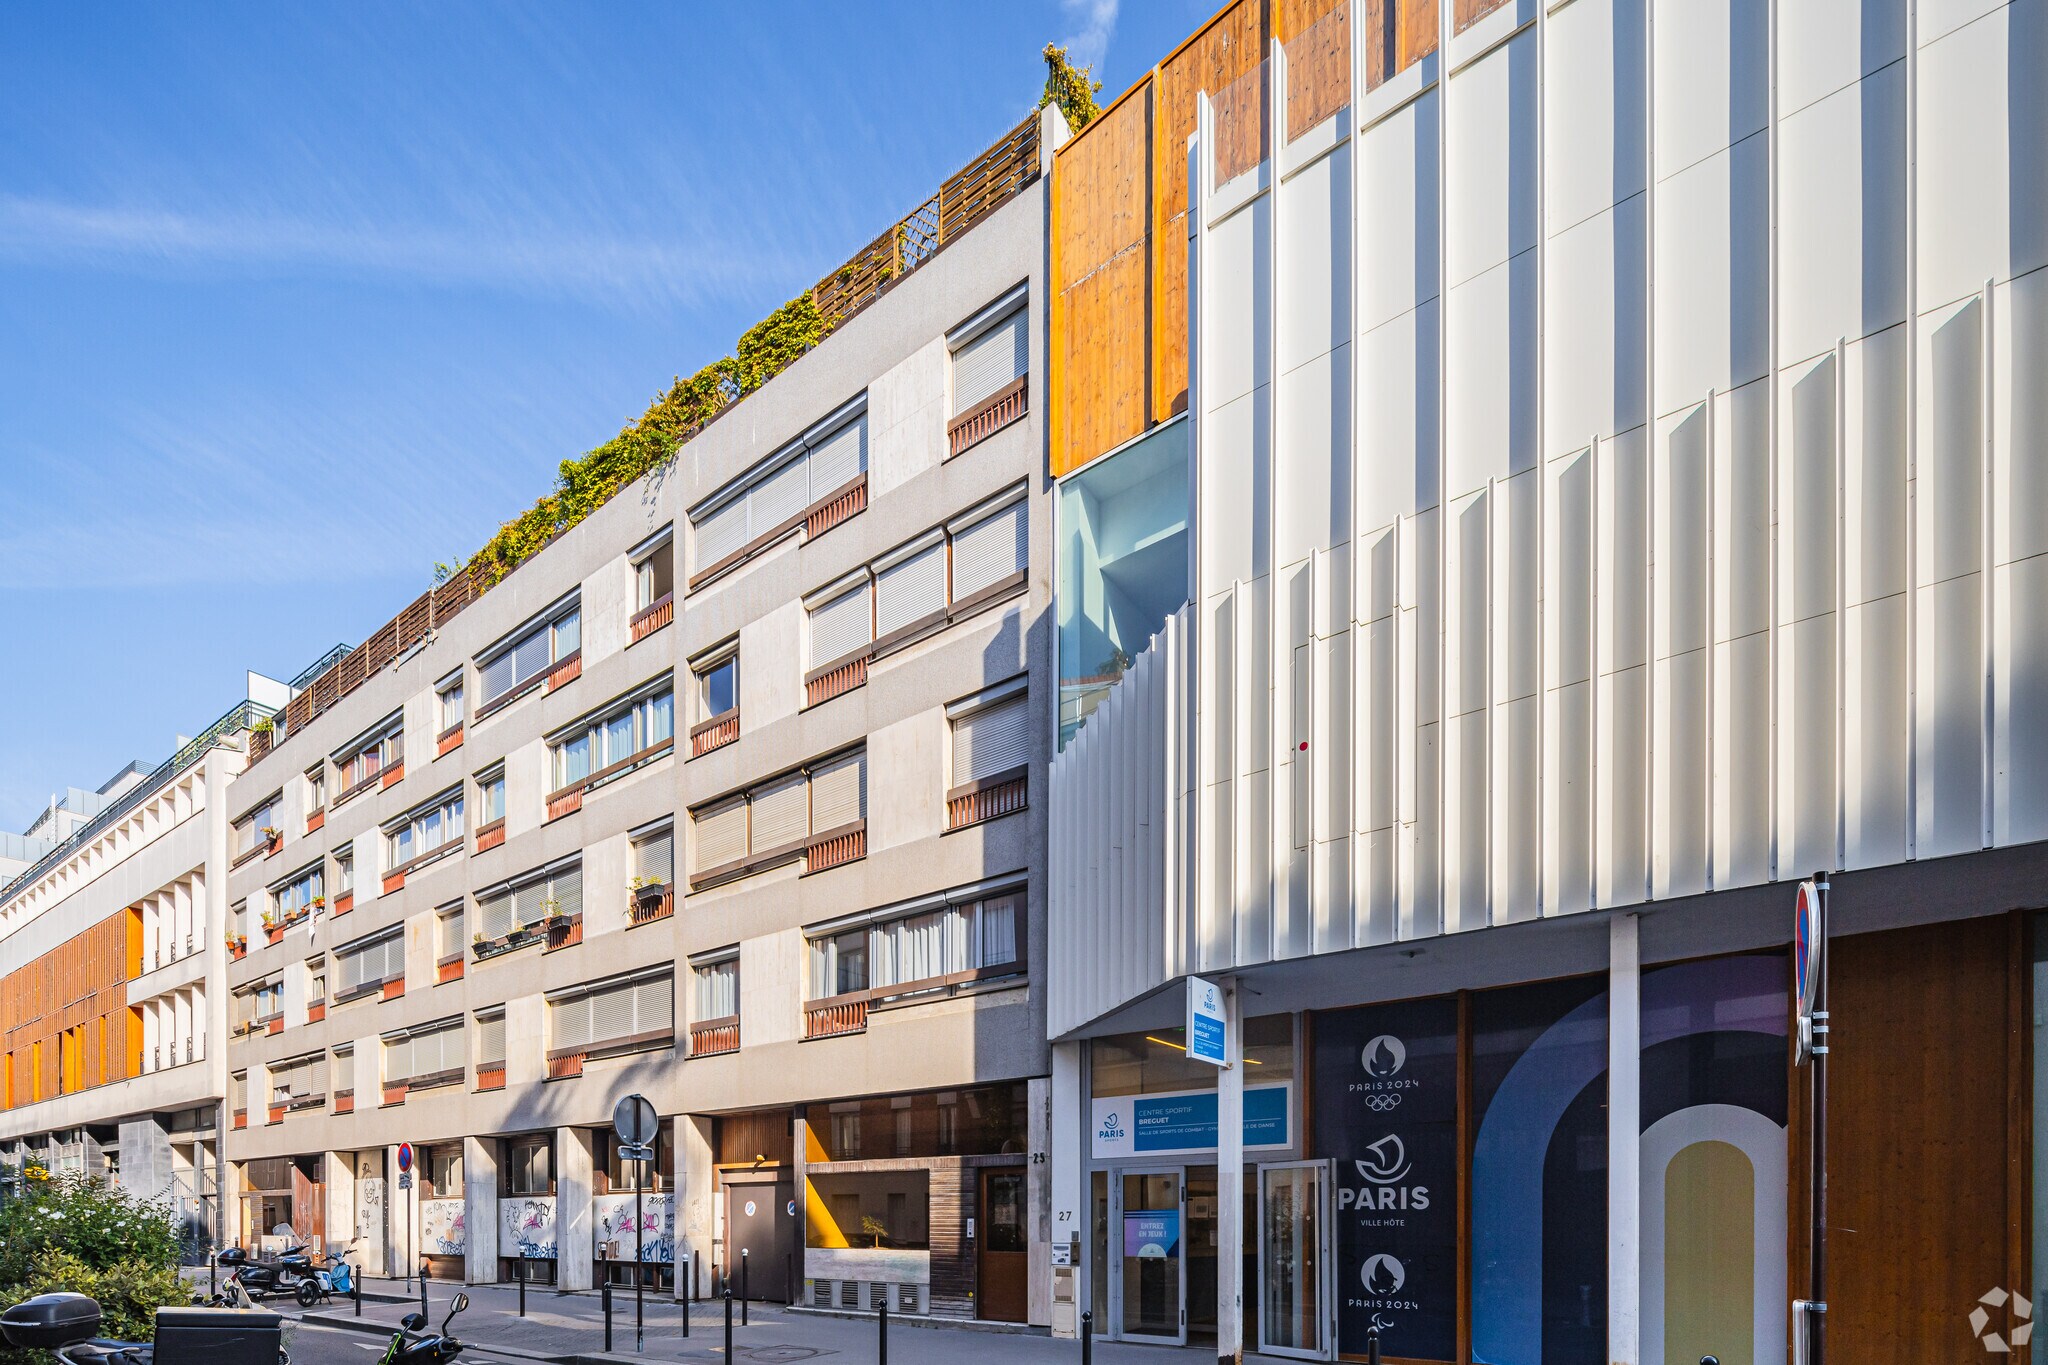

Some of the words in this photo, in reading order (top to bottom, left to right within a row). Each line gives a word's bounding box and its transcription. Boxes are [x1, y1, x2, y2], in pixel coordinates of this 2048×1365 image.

[1204, 1001, 1216, 1011] PARIS
[1349, 1082, 1383, 1092] PARIS
[1387, 1079, 1419, 1090] 2024
[1138, 1108, 1164, 1117] CENTRE
[1165, 1106, 1193, 1115] SPORTIF
[1138, 1116, 1170, 1125] BREGUET
[1099, 1129, 1124, 1138] PARIS
[1033, 1152, 1046, 1164] 25
[1338, 1186, 1430, 1211] PARIS
[1058, 1210, 1072, 1222] 27
[1140, 1222, 1164, 1230] ENTREZ
[1360, 1219, 1382, 1227] VILLE
[1383, 1218, 1405, 1227] HÔTE
[1138, 1230, 1147, 1238] EN
[1147, 1230, 1163, 1238] JEUX
[1348, 1298, 1382, 1308] PARIS
[1386, 1300, 1418, 1310] 2024
